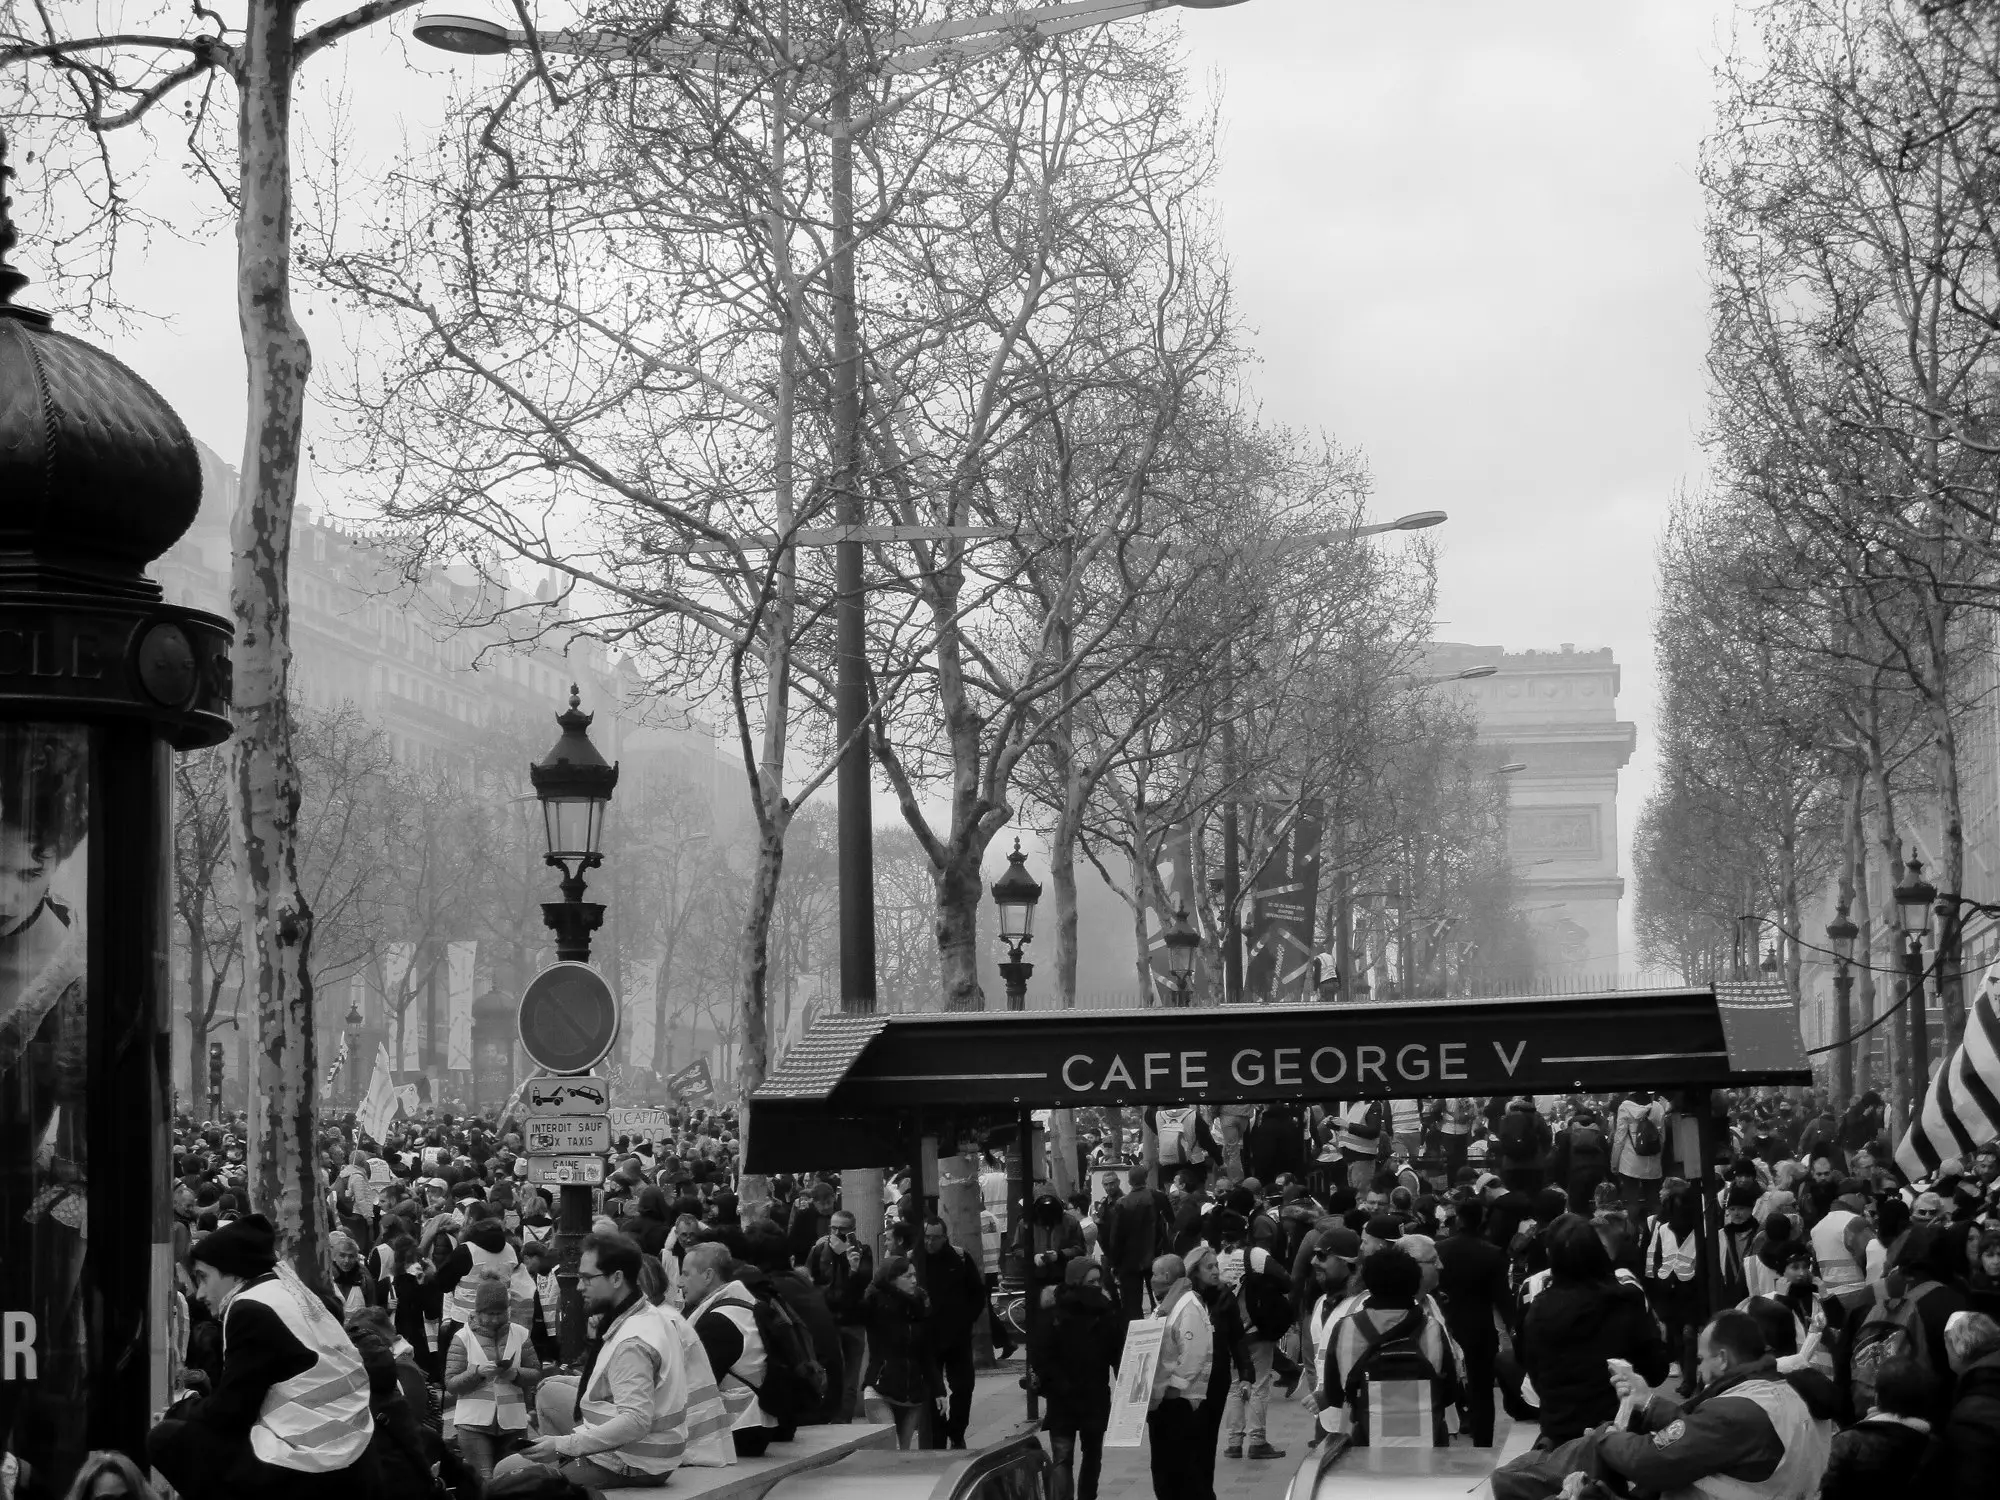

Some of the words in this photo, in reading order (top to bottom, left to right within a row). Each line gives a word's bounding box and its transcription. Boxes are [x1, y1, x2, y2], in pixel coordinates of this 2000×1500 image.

[1062, 1051, 1209, 1091] CAFE
[1231, 1043, 1468, 1086] GEORGE
[1492, 1040, 1527, 1077] V
[532, 1123, 572, 1133] INTERDIT
[578, 1122, 603, 1132] SAUF
[567, 1136, 593, 1147] TAXIS
